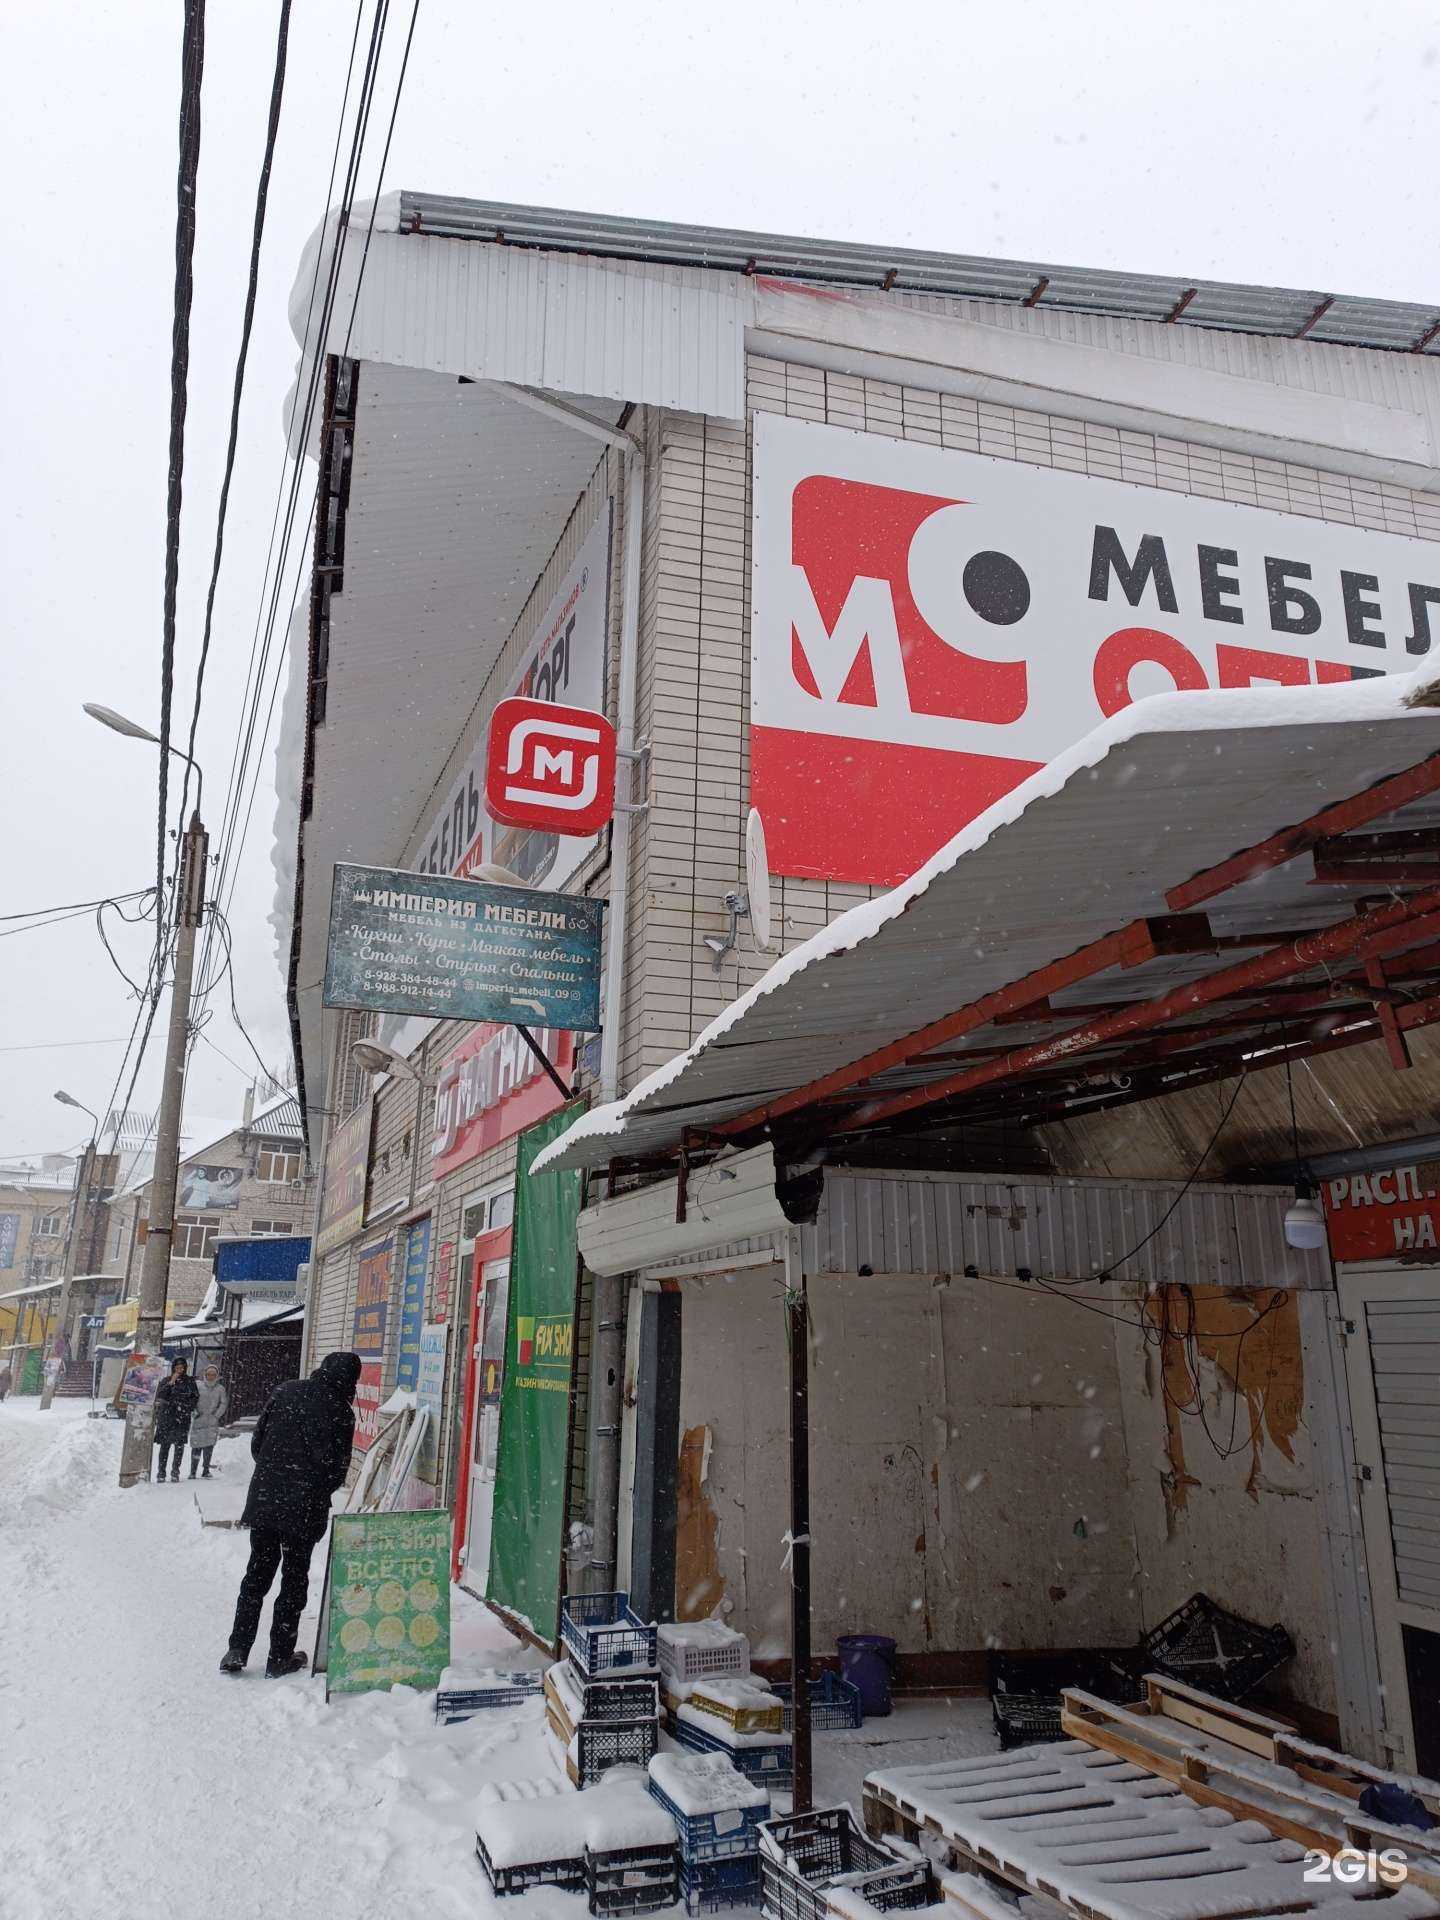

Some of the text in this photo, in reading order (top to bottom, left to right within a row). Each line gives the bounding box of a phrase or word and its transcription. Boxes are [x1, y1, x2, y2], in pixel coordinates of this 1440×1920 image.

[373, 890, 566, 929] ИМПЕРИЯ МЕБЕЛИ
[388, 911, 552, 940] МЕБЕЛЬ ИЗ ДАГЕСТАНА
[351, 924, 585, 965] Кухни Купе Мягкая мебель
[359, 946, 577, 983] Столы Стулья Спальни
[1329, 1165, 1436, 1210] РАСП.
[1392, 1213, 1438, 1250] НА
